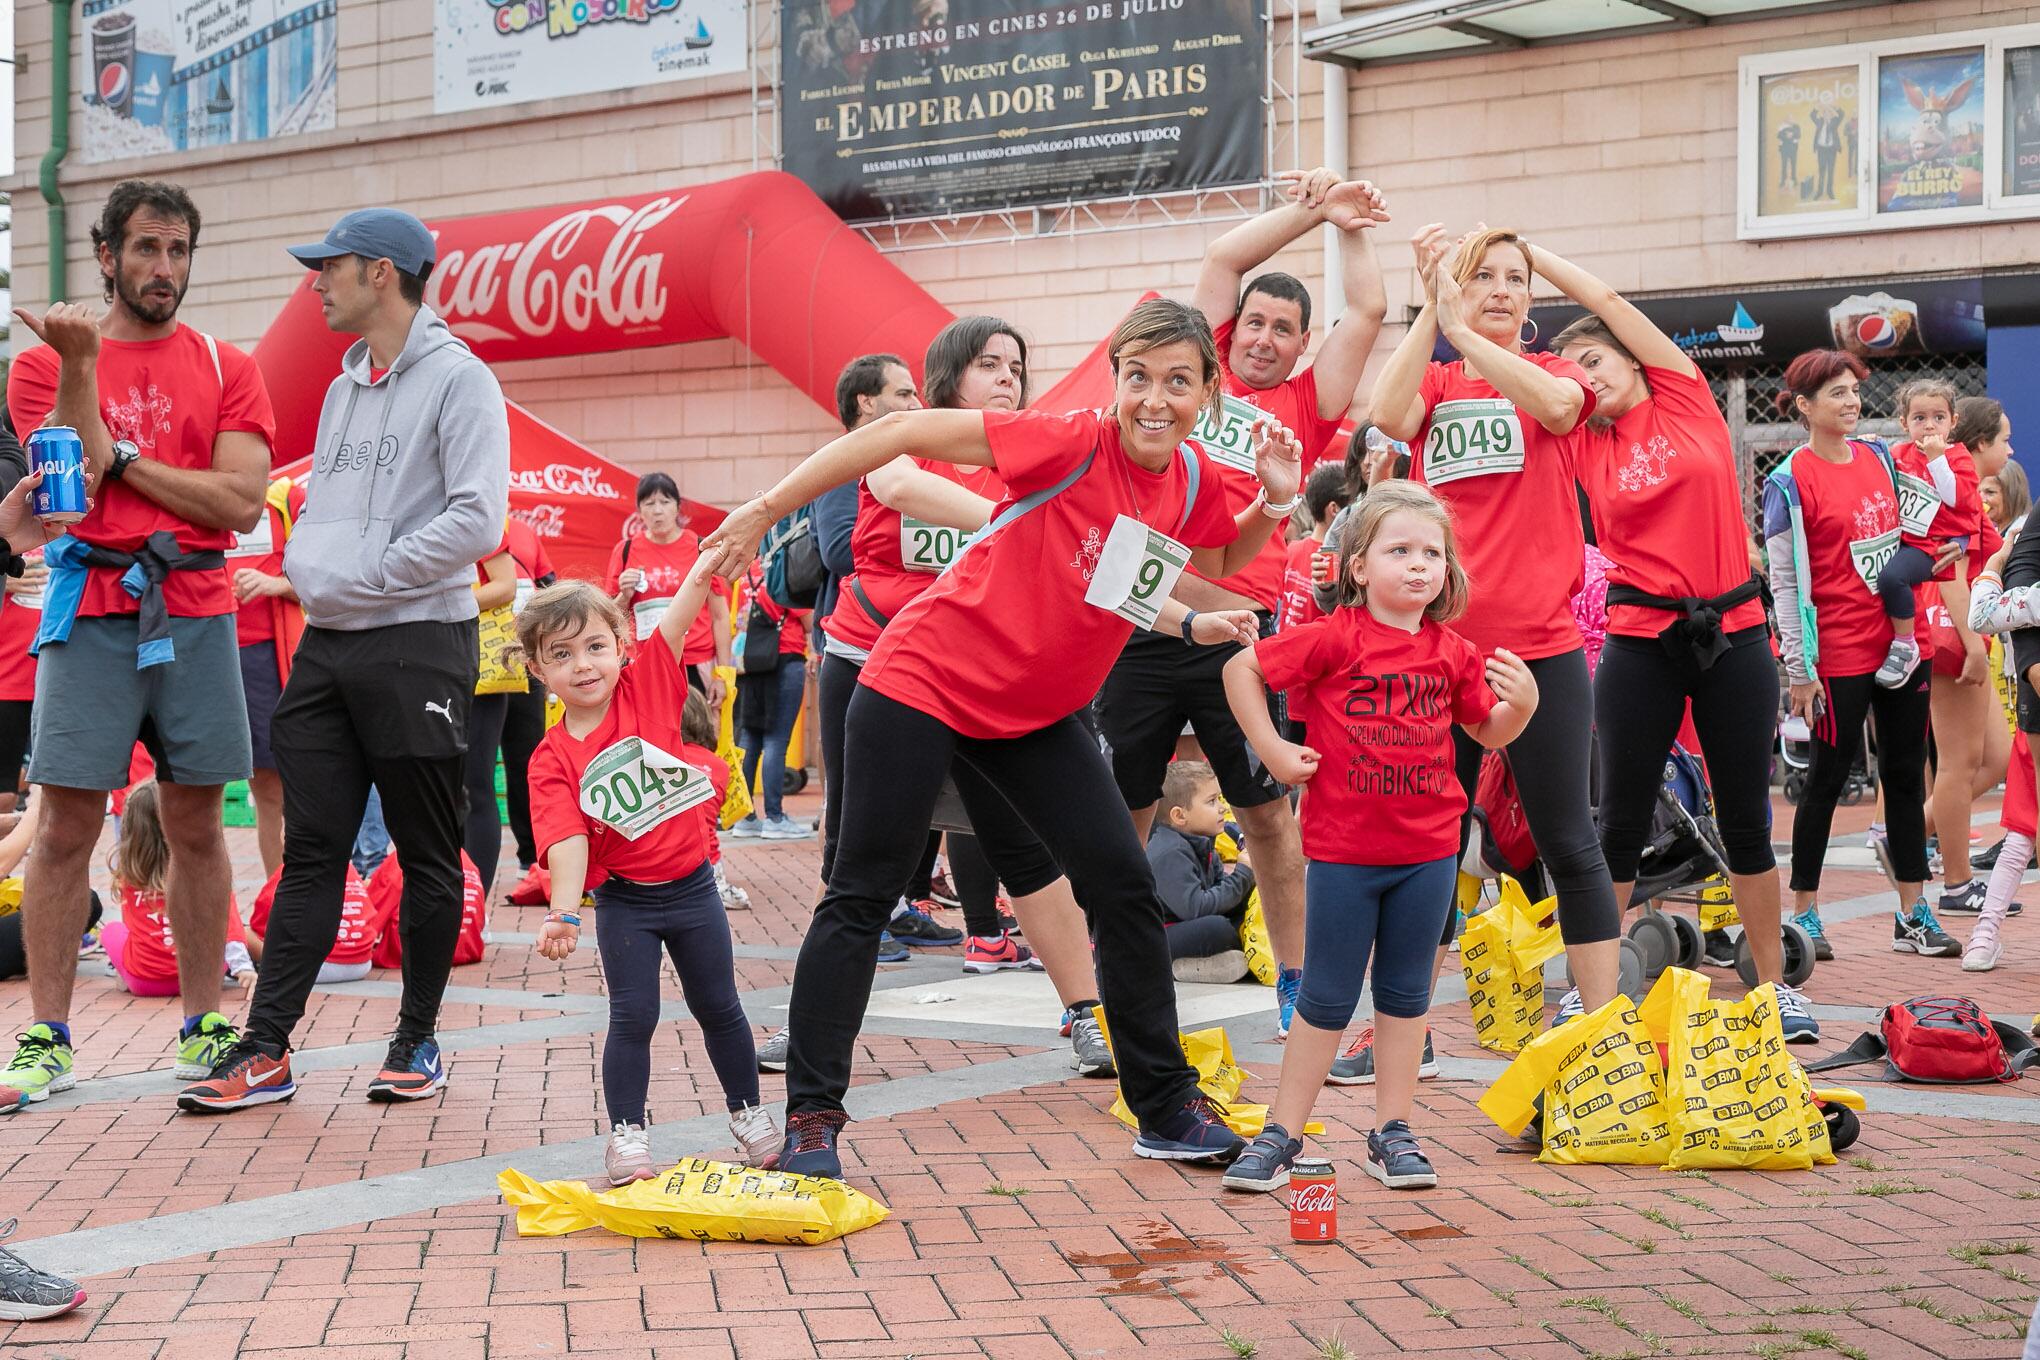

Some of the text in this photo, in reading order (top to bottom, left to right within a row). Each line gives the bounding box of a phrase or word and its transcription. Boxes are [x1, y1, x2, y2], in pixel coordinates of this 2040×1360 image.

[497, 0, 545, 31] CON
[860, 0, 1184, 53] ESTRENO EN CINES 26 DE JULIO
[940, 53, 1070, 85] VINCENT CASSEL
[1771, 80, 1859, 106] @buelo
[815, 64, 1207, 142] EL EMPERADOR DE PARIS
[1073, 132, 1132, 150] FRANÇOIS
[1132, 125, 1181, 145] VIDOCQ
[2019, 153, 2040, 166] DO
[424, 194, 691, 337] ca-Cola
[1684, 342, 1765, 359] zinemak
[1430, 418, 1512, 464] 2049
[318, 432, 399, 473] Jeep
[510, 463, 619, 499] ca-Cola
[1898, 489, 1931, 519] 037
[1700, 1009, 1715, 1025] BM
[1606, 1033, 1627, 1048] BM
[1708, 1038, 1726, 1052] BM
[1569, 1043, 1586, 1062] BM
[1577, 1067, 1596, 1083] BM
[1622, 1062, 1641, 1077] BM
[1719, 1070, 1737, 1084] BM
[1590, 1095, 1610, 1111] BM
[1637, 1093, 1657, 1108] BM
[1731, 1103, 1749, 1116] BM
[1653, 1124, 1669, 1138] BM
[1788, 1129, 1802, 1145] BM
[1585, 1138, 1609, 1147] MATERIAL
[1610, 1137, 1637, 1146] RECICLADO
[1290, 1183, 1336, 1211] a-Cola
